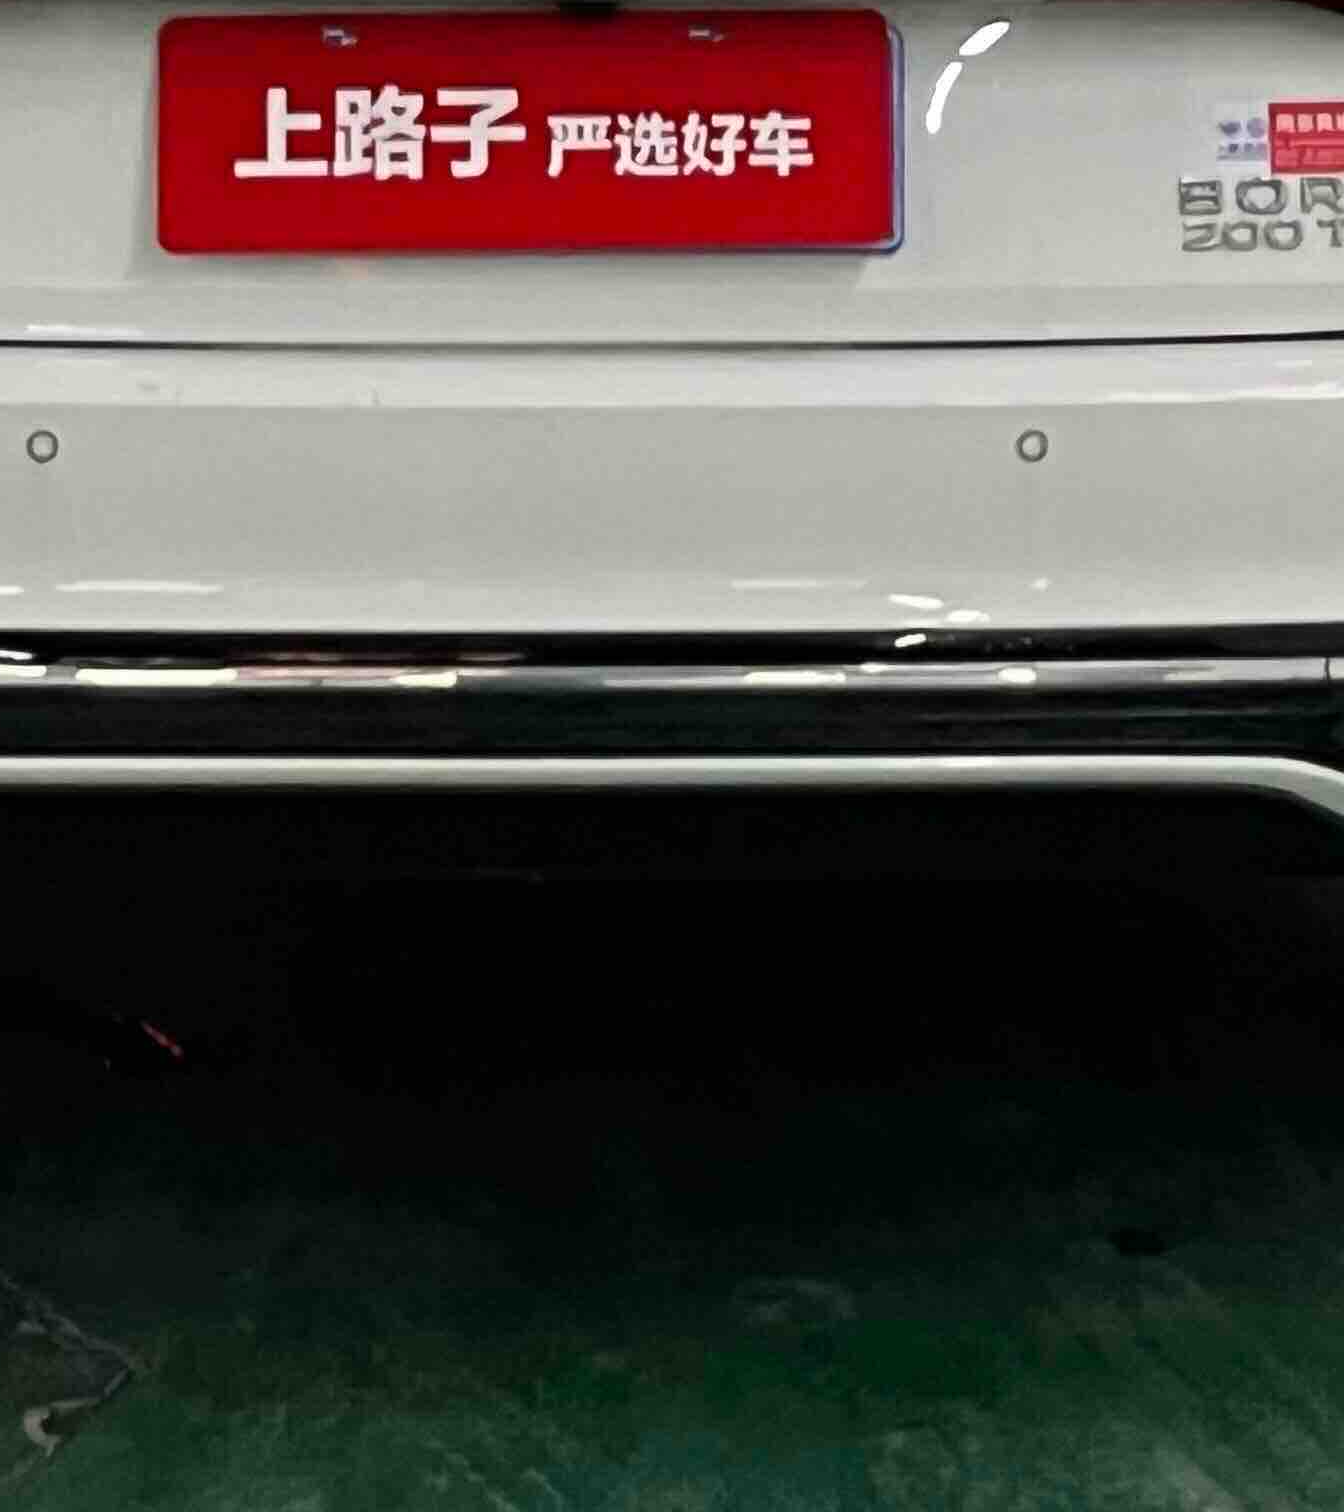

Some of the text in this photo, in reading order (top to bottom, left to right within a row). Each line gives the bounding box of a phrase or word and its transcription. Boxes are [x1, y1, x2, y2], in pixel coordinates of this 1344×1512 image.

[234, 84, 814, 181] 上路子 严选好车
